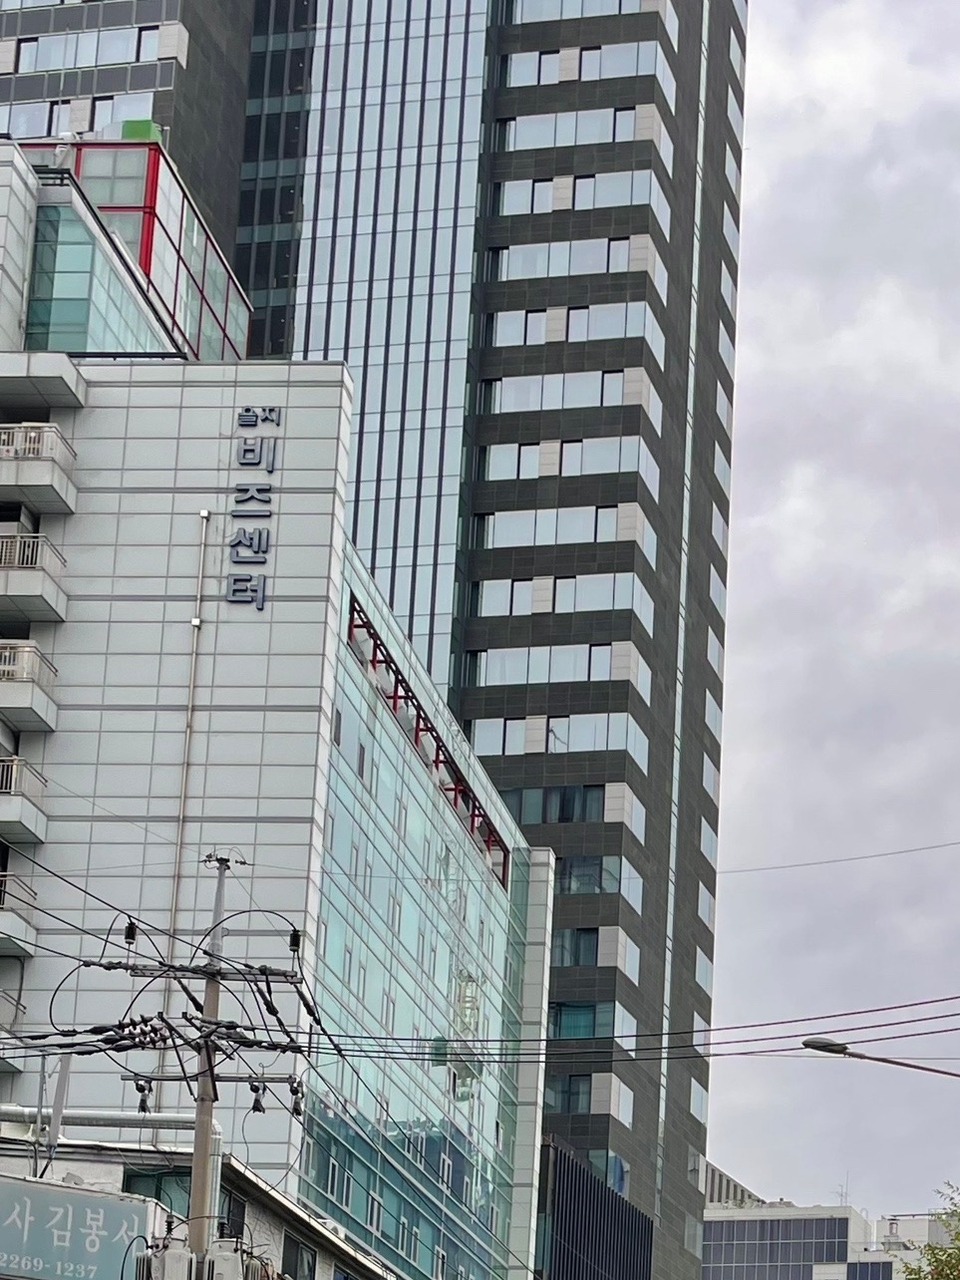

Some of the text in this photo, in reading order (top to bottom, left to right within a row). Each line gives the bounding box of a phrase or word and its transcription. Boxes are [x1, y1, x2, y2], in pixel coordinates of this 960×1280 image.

[237, 405, 281, 427] 을지
[226, 436, 277, 611] 비즈센터
[0, 1252, 98, 1279] 2269-1237
